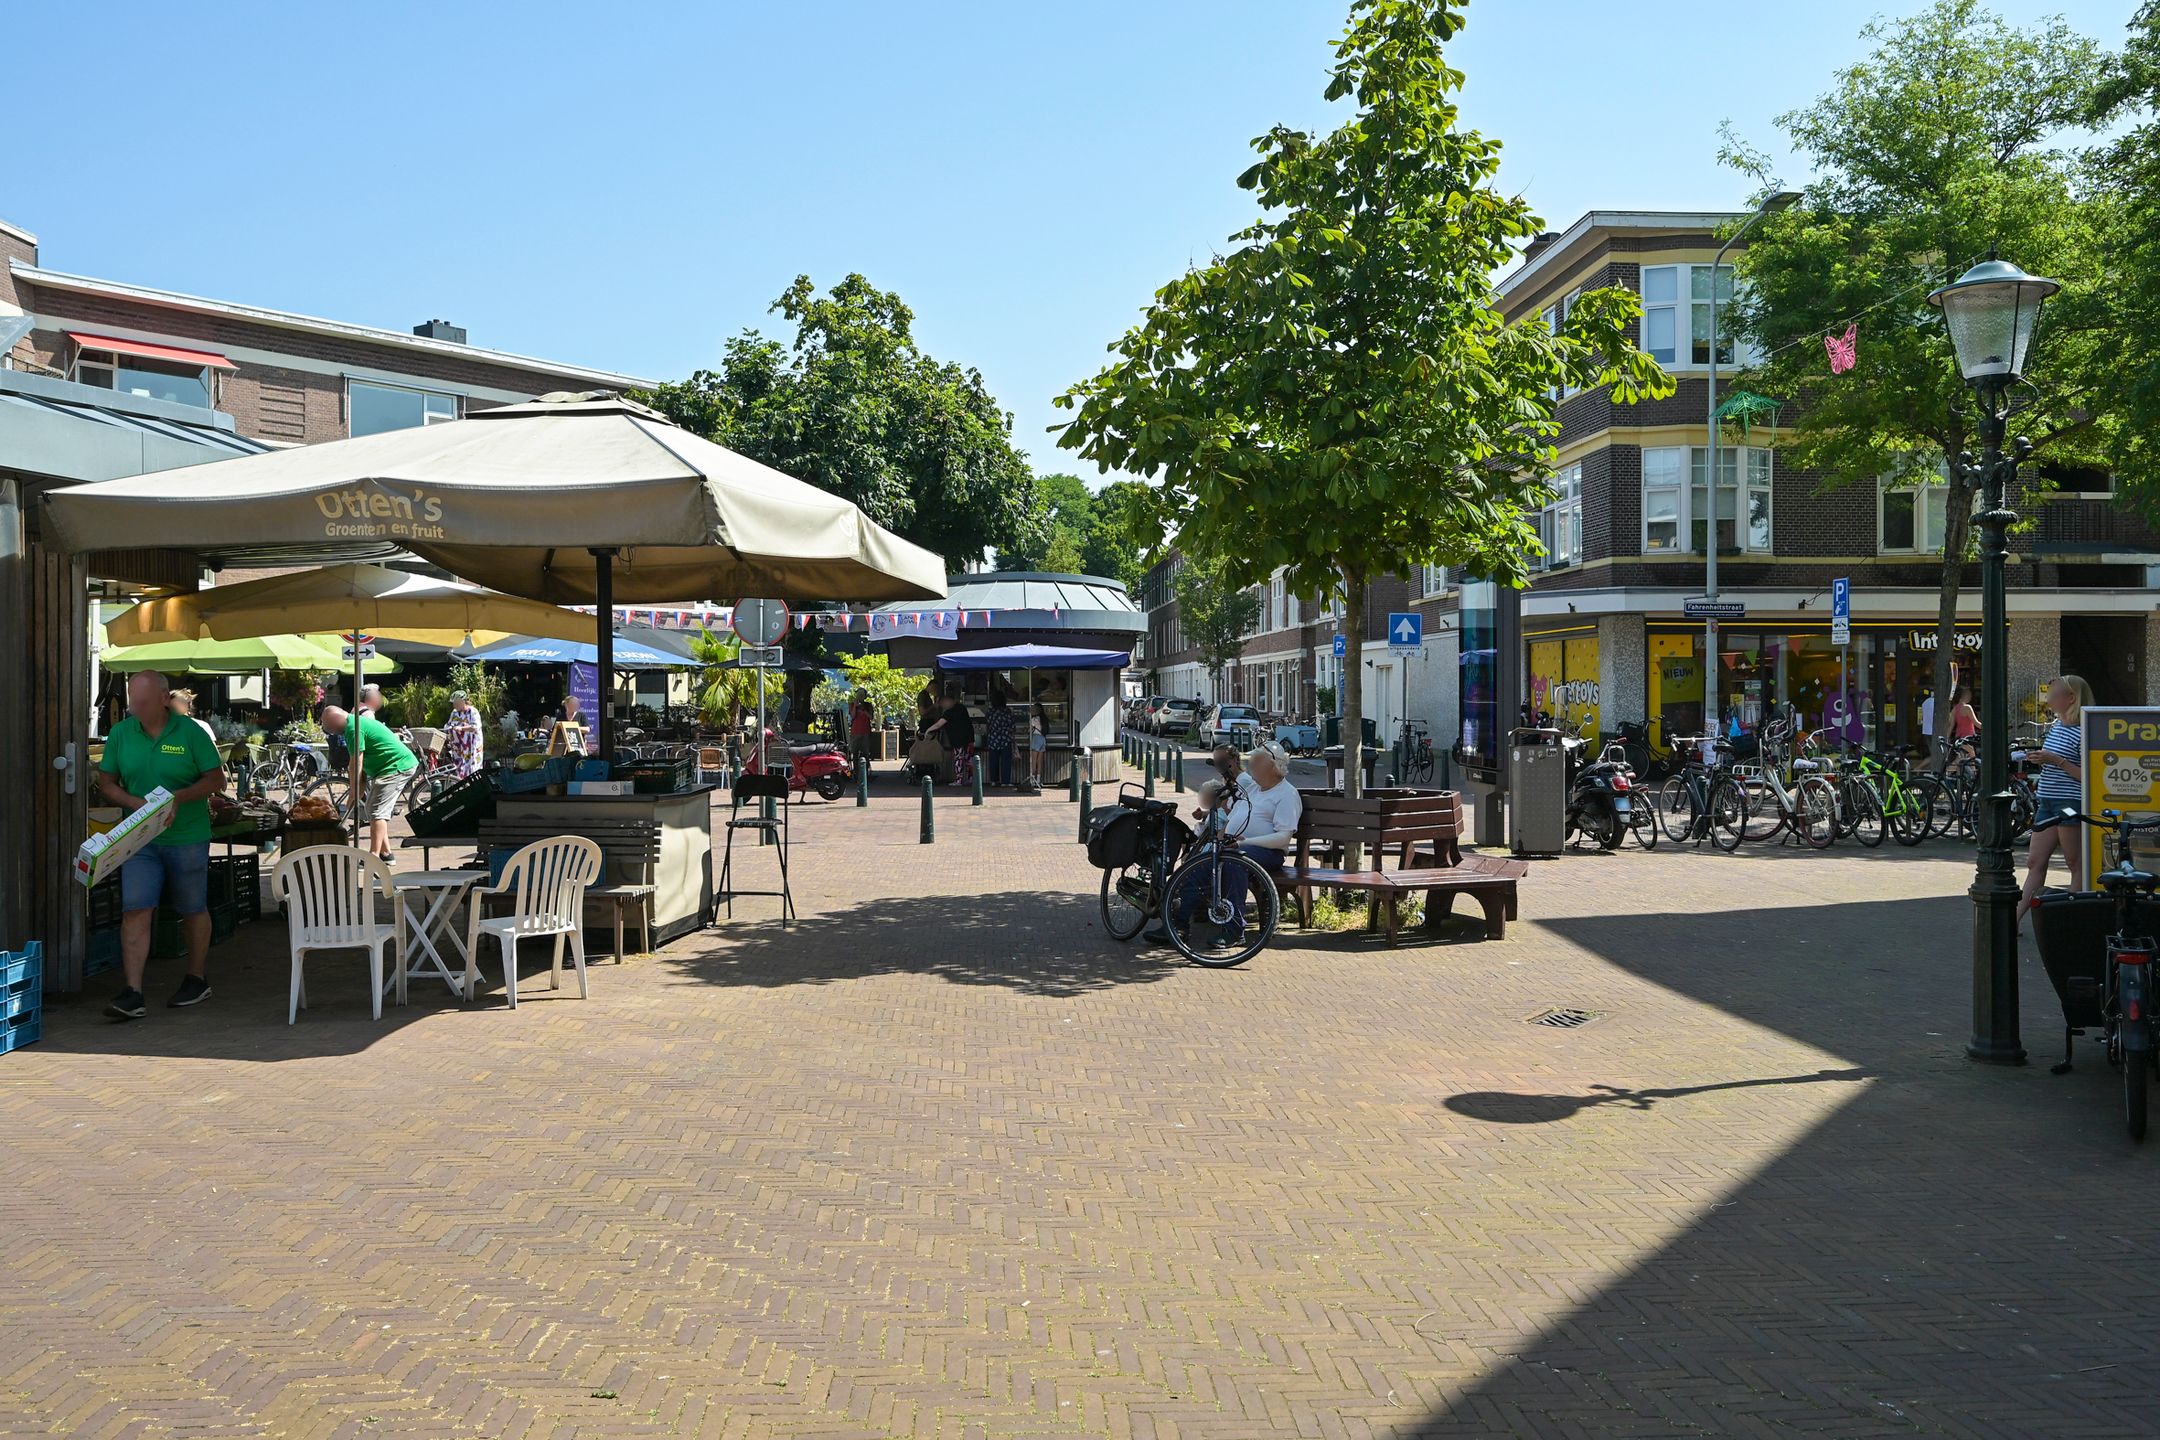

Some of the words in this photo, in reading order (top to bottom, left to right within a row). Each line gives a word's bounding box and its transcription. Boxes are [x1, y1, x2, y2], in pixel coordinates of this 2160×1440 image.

[314, 489, 443, 522] Otten's
[325, 522, 387, 537] Groenten
[391, 522, 409, 535] en
[411, 523, 444, 539] fruit
[1663, 667, 1694, 681] NIEUW
[2108, 718, 2160, 741] Pra
[161, 744, 185, 752] Otten's
[2107, 768, 2148, 782] 40%
